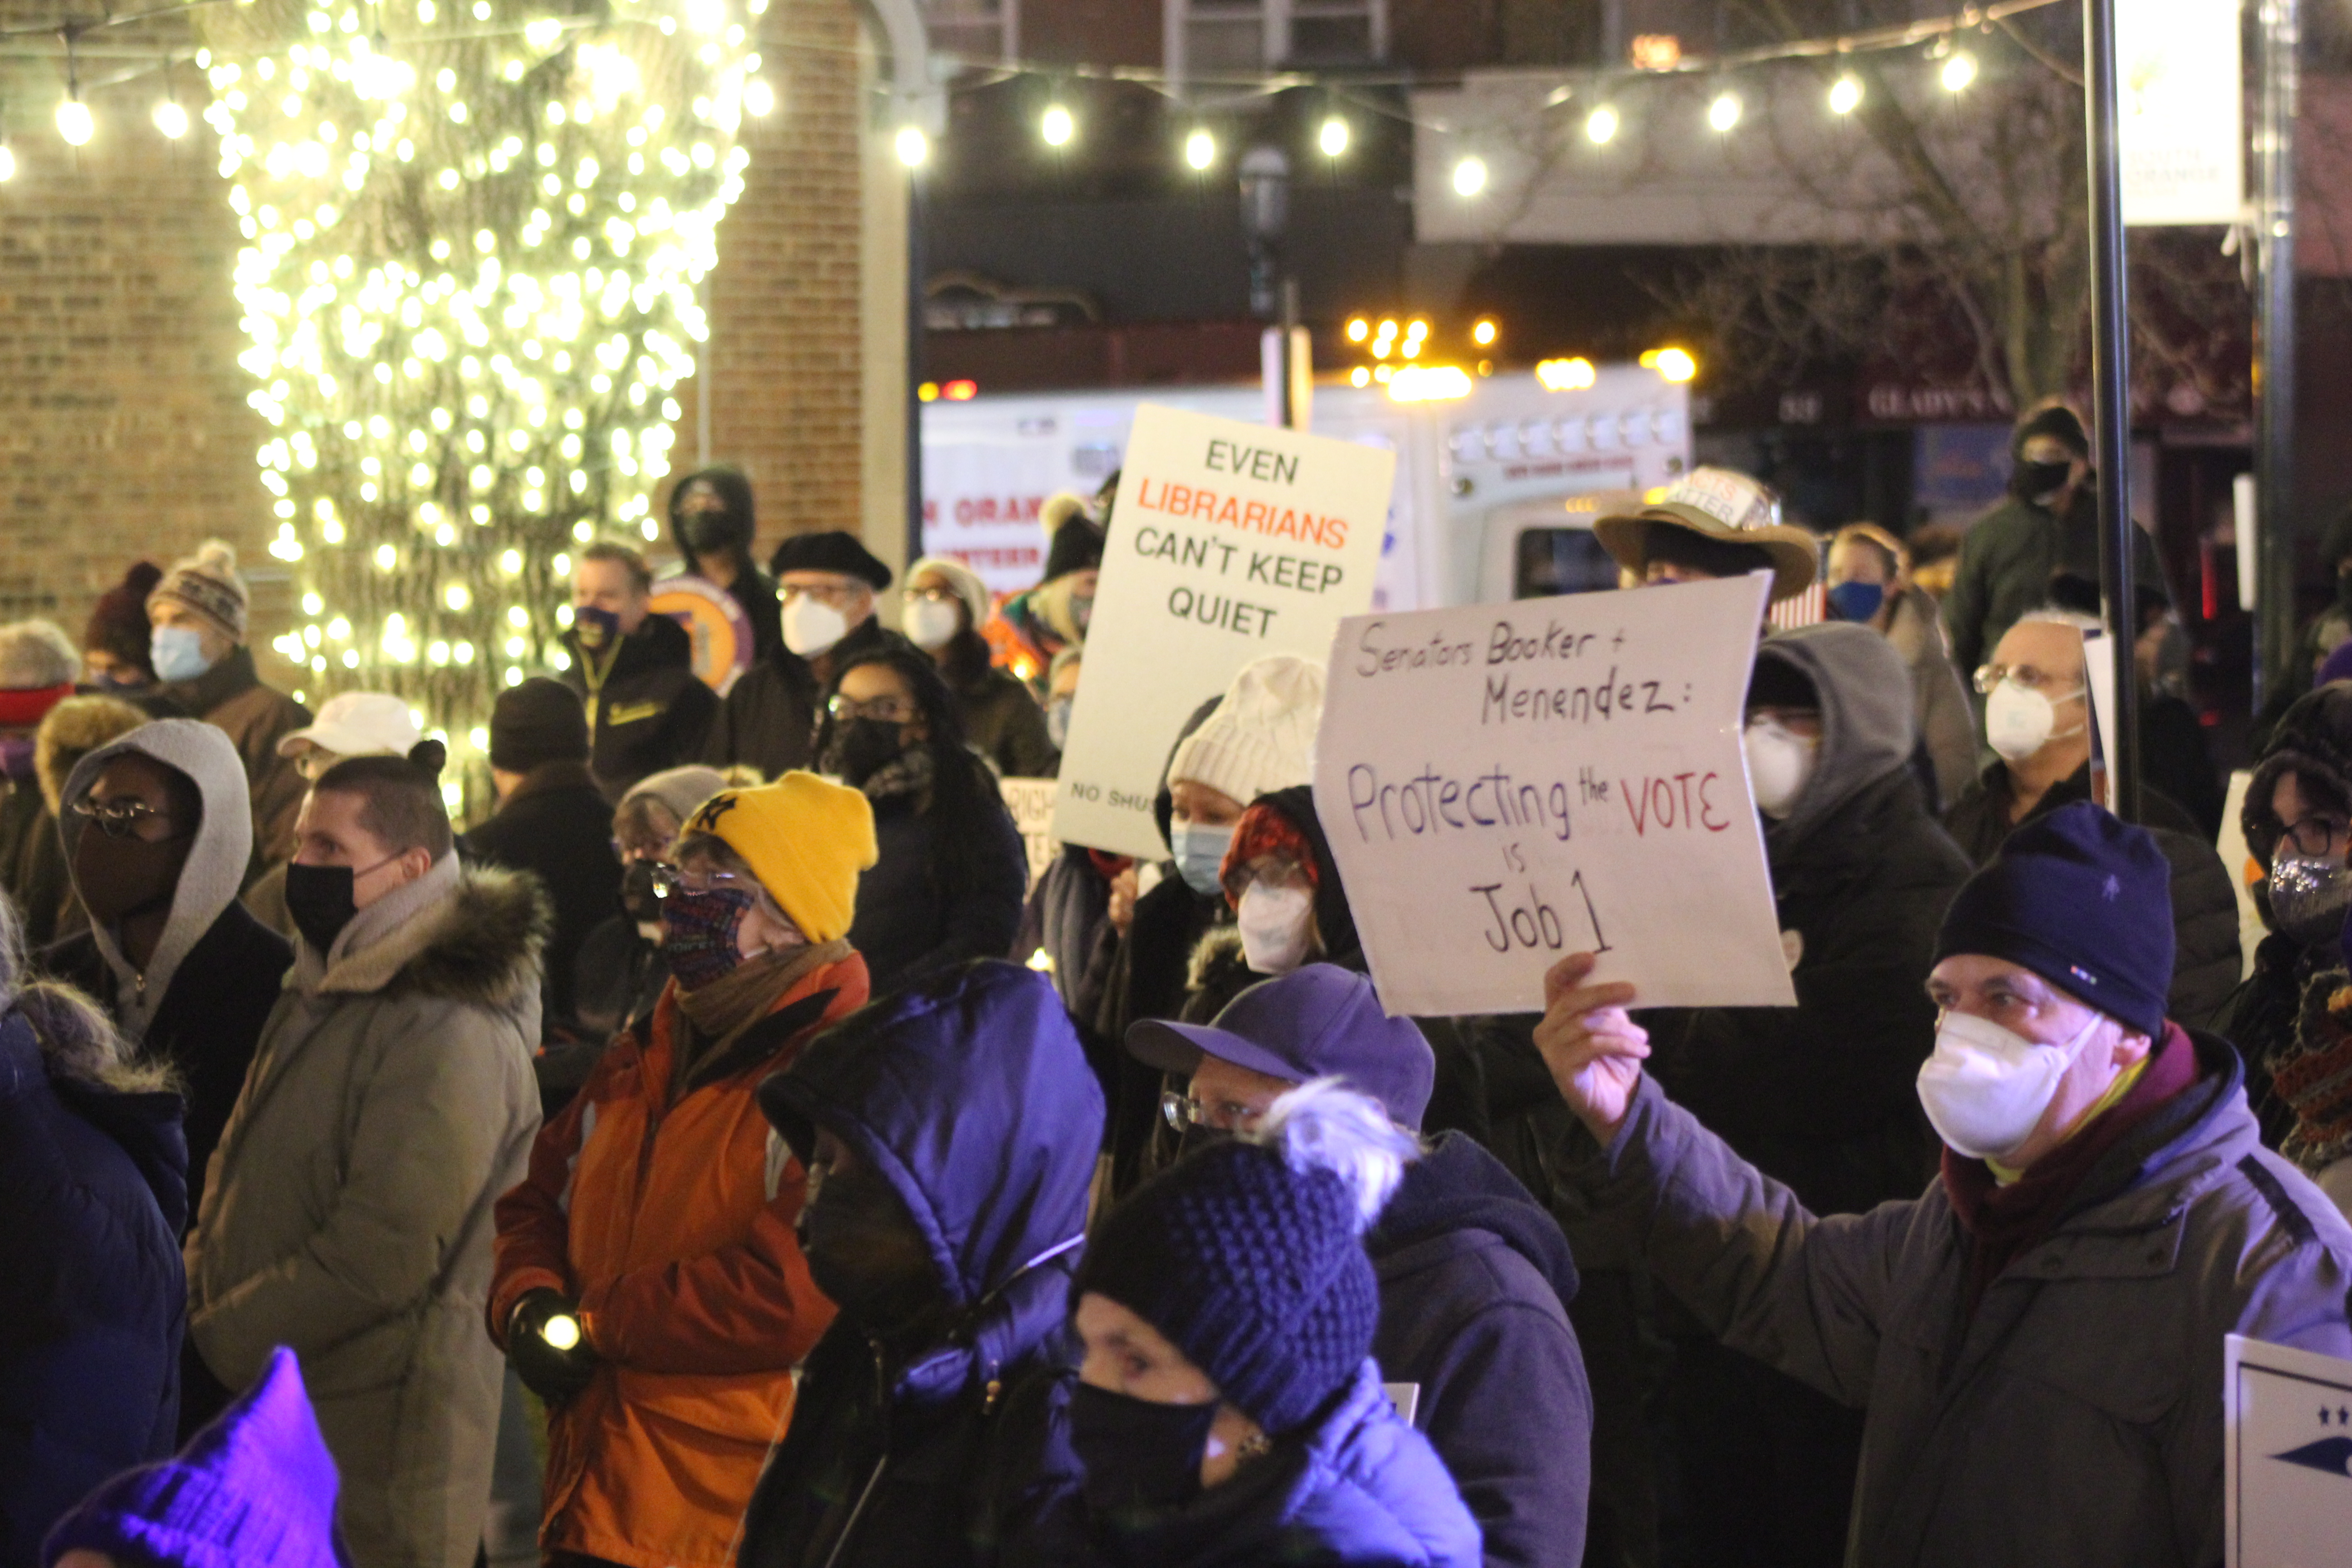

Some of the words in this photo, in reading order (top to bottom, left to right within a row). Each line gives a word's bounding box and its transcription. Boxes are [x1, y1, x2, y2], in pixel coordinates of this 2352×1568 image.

[1205, 440, 1298, 485] EVEN
[1138, 479, 1348, 549] LIBRARIANS
[1135, 528, 1238, 574] CAN'T
[1247, 553, 1344, 594] KEEP
[1167, 587, 1277, 638] QUIET
[1356, 621, 1474, 678] Senators
[1486, 620, 1598, 666] Booker
[1481, 666, 1692, 724] Menendez:
[1071, 782, 1100, 802] NO
[1348, 762, 1572, 843] Protecting
[1579, 766, 1608, 806] the
[1620, 772, 1730, 838] VOTE
[1469, 881, 1563, 953] Job
[1570, 869, 1612, 953] 1
